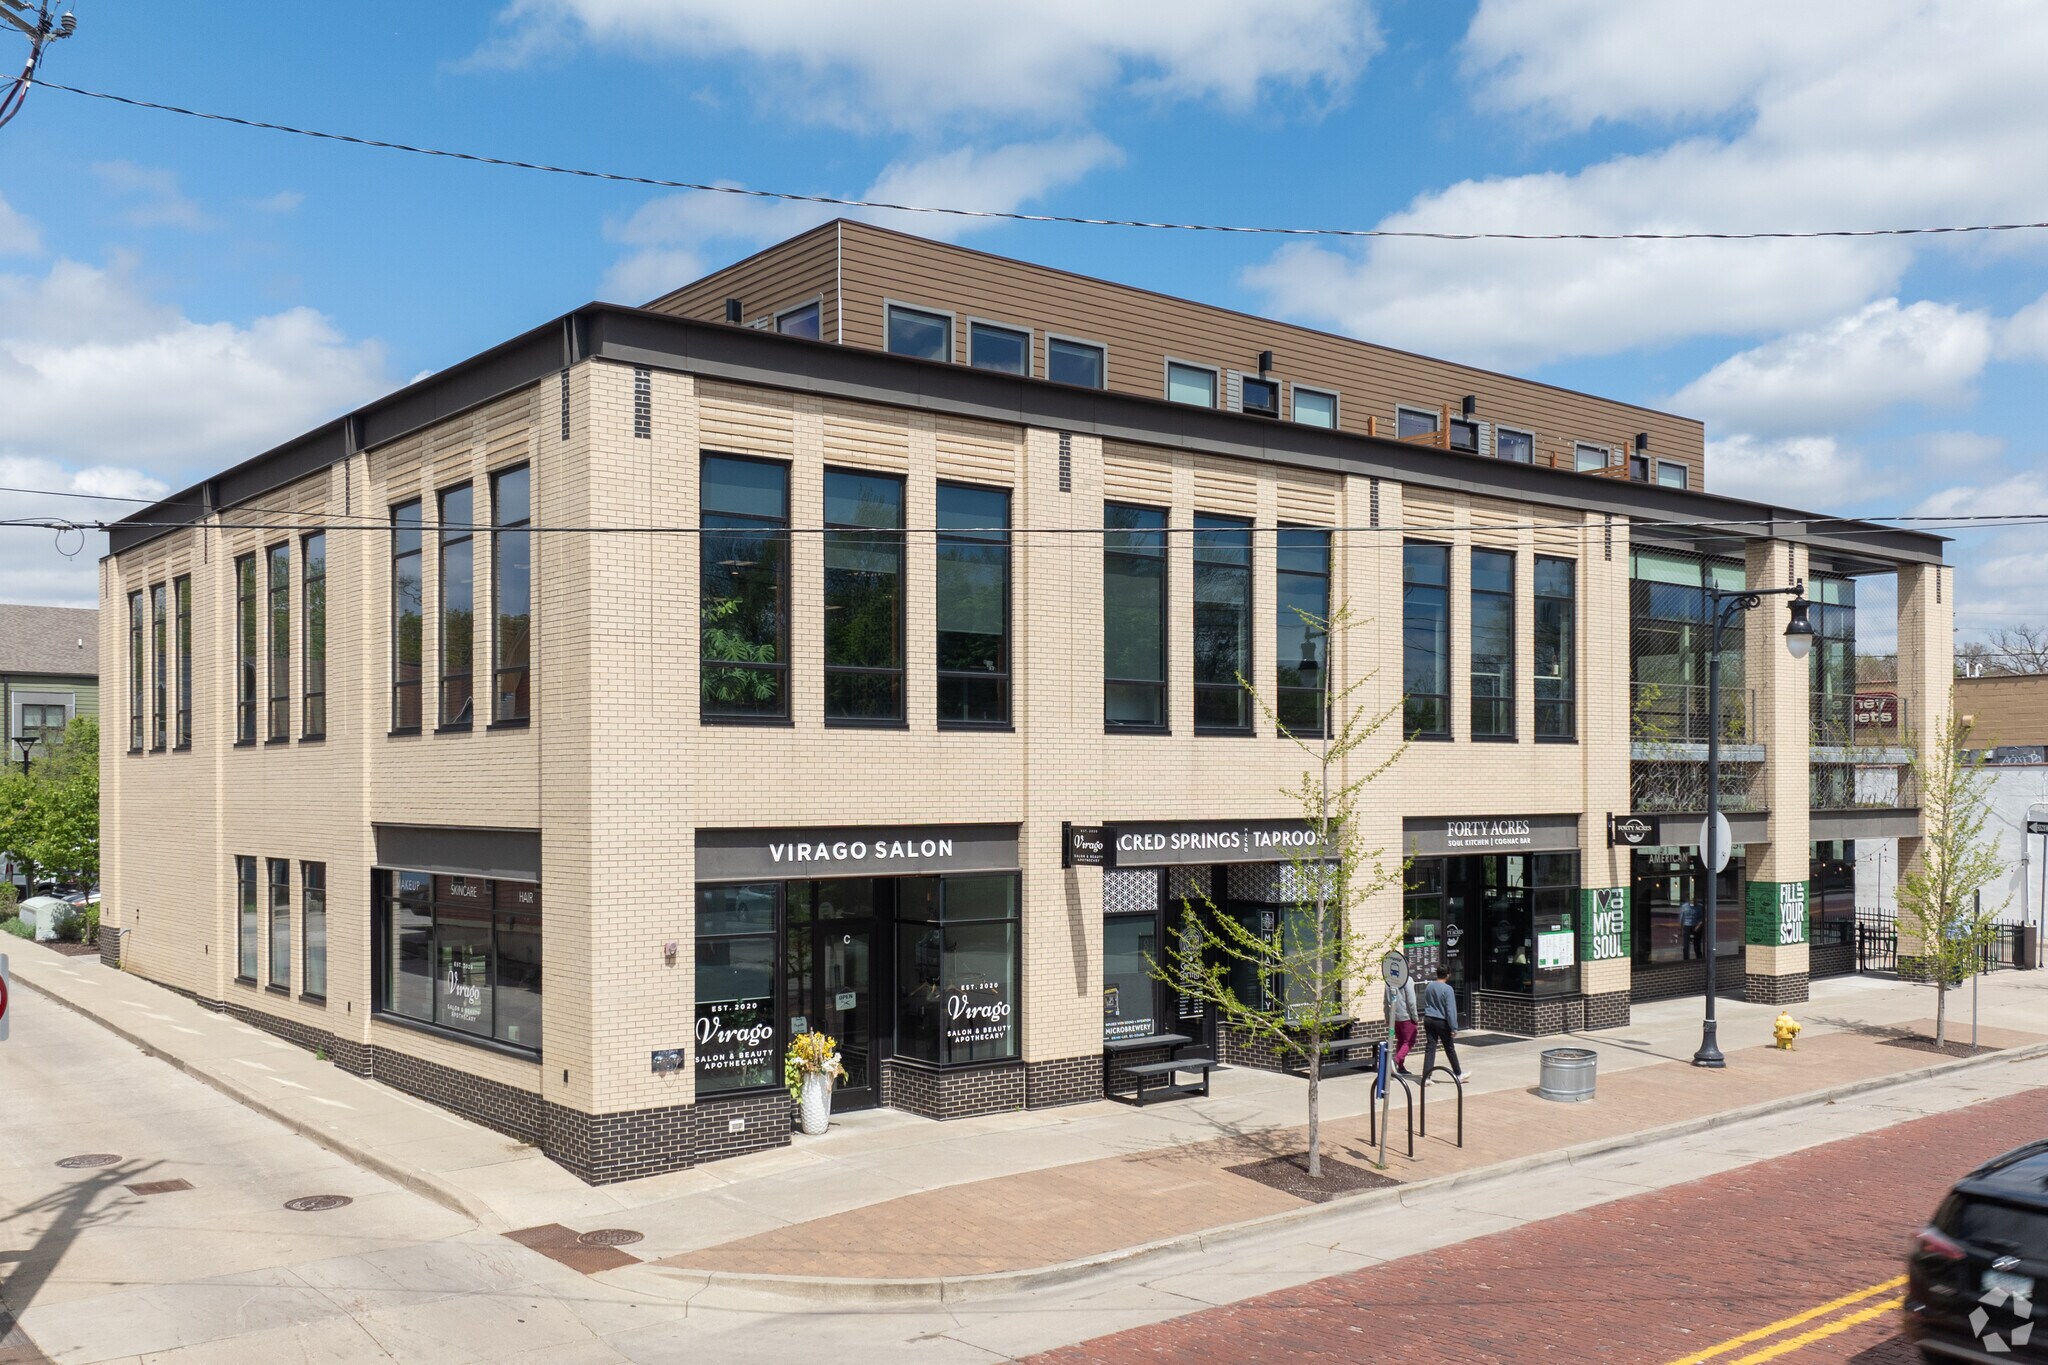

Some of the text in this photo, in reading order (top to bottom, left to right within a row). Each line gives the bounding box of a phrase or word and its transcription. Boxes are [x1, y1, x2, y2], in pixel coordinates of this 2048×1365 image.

[1855, 711, 1892, 722] ets
[1447, 820, 1530, 837] FORTY ACRES
[1074, 834, 1103, 853] Virago
[1171, 831, 1240, 850] SPRINGS
[769, 840, 953, 862] VIRAGO SALON
[1649, 852, 1688, 864] AMERICAN
[397, 880, 420, 891] MAKEUP
[451, 884, 477, 898] SKINCARE
[1780, 883, 1797, 903] FILL
[1797, 882, 1804, 902] UP
[519, 891, 534, 904] HAIR
[1593, 890, 1597, 913] I
[1611, 888, 1624, 934] FOOD
[1780, 902, 1804, 923] YOUR
[1593, 912, 1612, 936] MY
[1780, 922, 1804, 944] SOUL
[843, 934, 851, 944] C
[1593, 934, 1624, 960] SOUL
[448, 970, 480, 1004] Virago
[948, 995, 1010, 1022] Virago
[696, 1016, 773, 1046] Virago
[947, 1029, 972, 1037] SALON
[983, 1025, 1011, 1033] BEAUTY
[955, 1032, 1004, 1043] APOTHECARY
[1105, 1024, 1151, 1034] MICROBREWERY
[695, 1054, 725, 1063] SALON
[739, 1049, 773, 1059] BEAUTY
[704, 1058, 764, 1070] APOTHECARY
